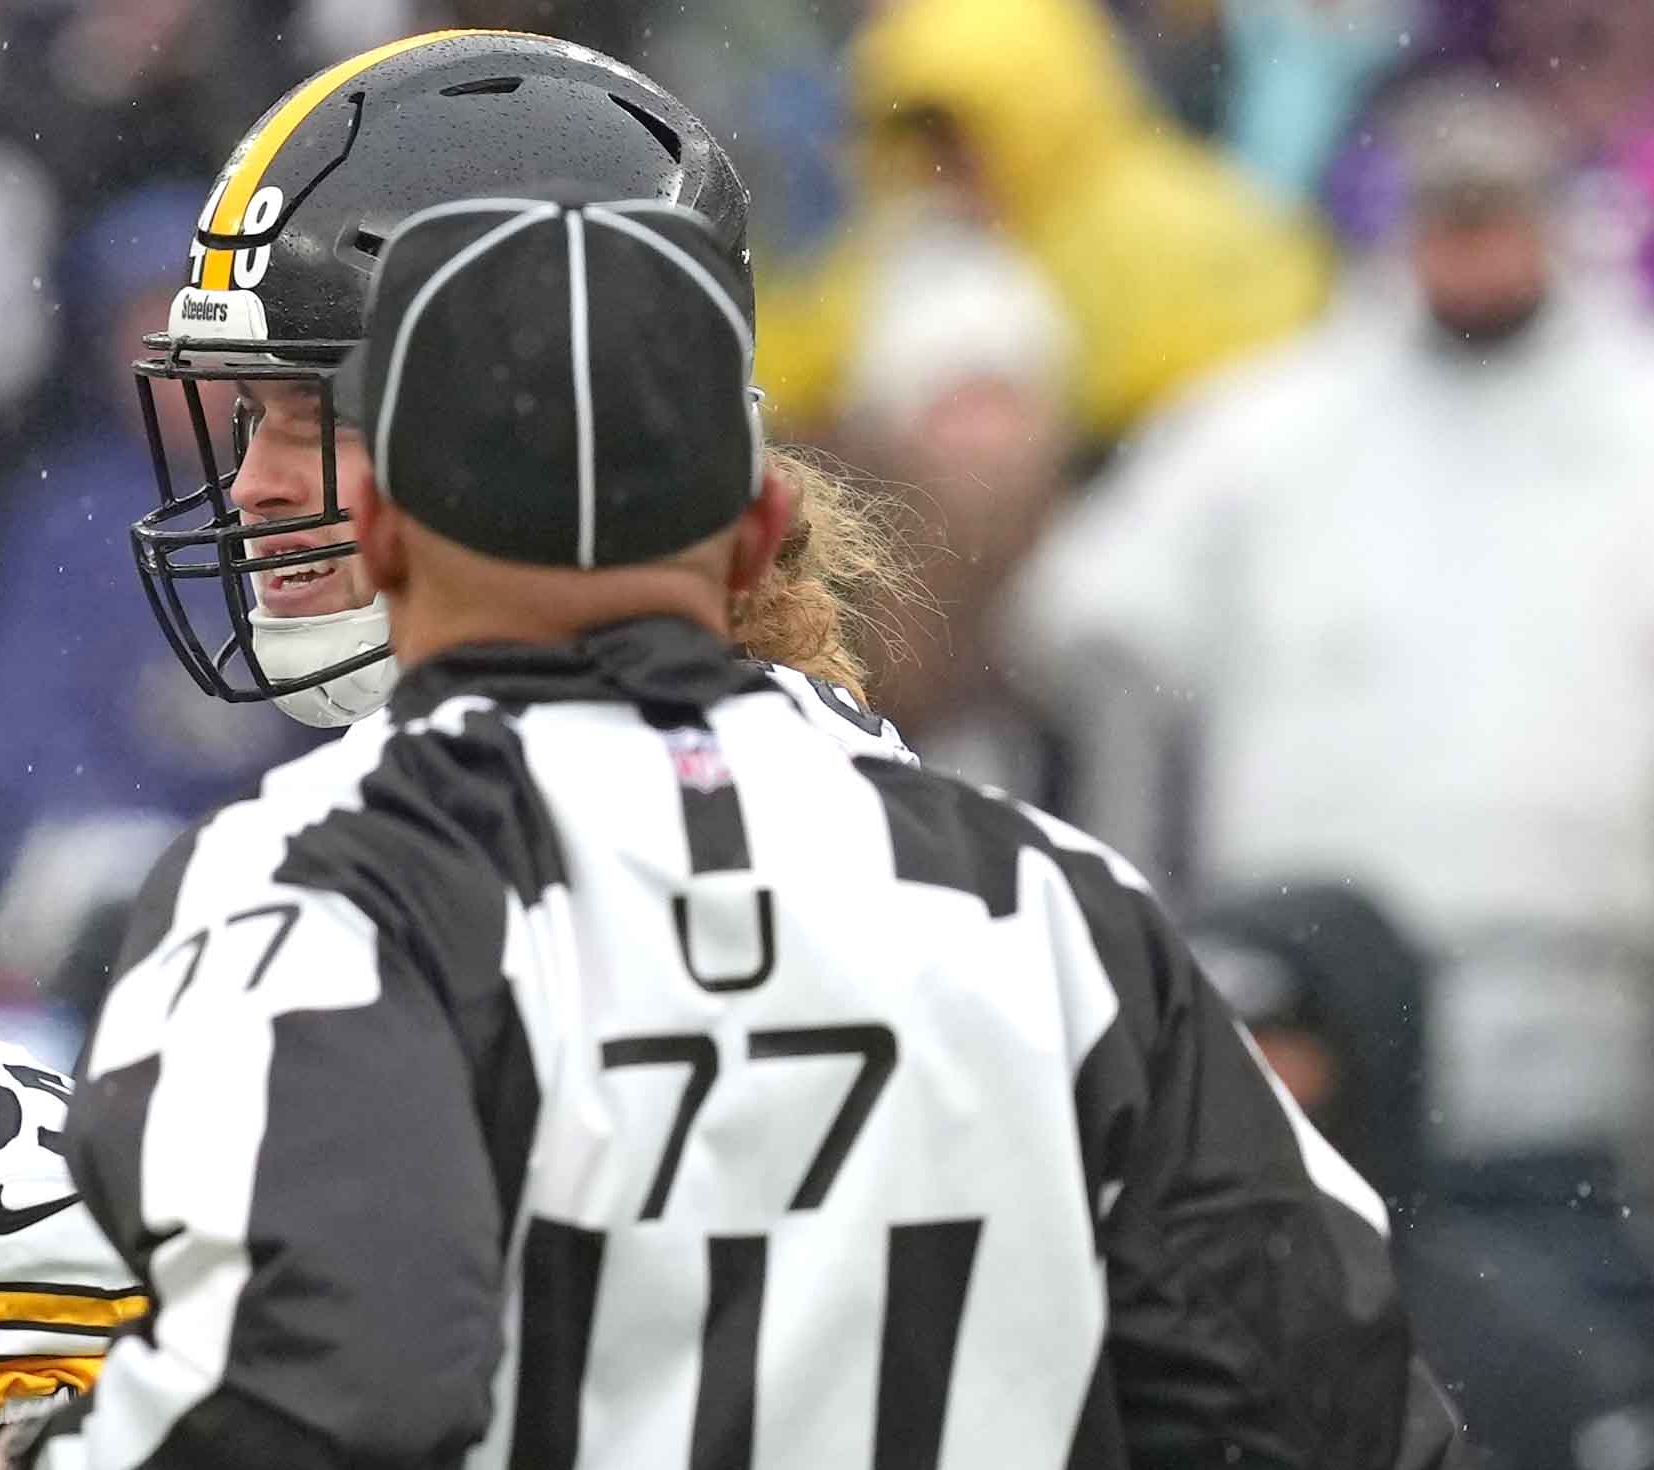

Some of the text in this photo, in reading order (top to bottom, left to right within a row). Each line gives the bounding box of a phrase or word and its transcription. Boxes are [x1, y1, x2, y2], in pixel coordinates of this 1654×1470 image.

[181, 293, 229, 322] Steelers
[160, 901, 303, 1022] 77
[673, 888, 775, 992] U
[599, 1022, 899, 1222] 77
